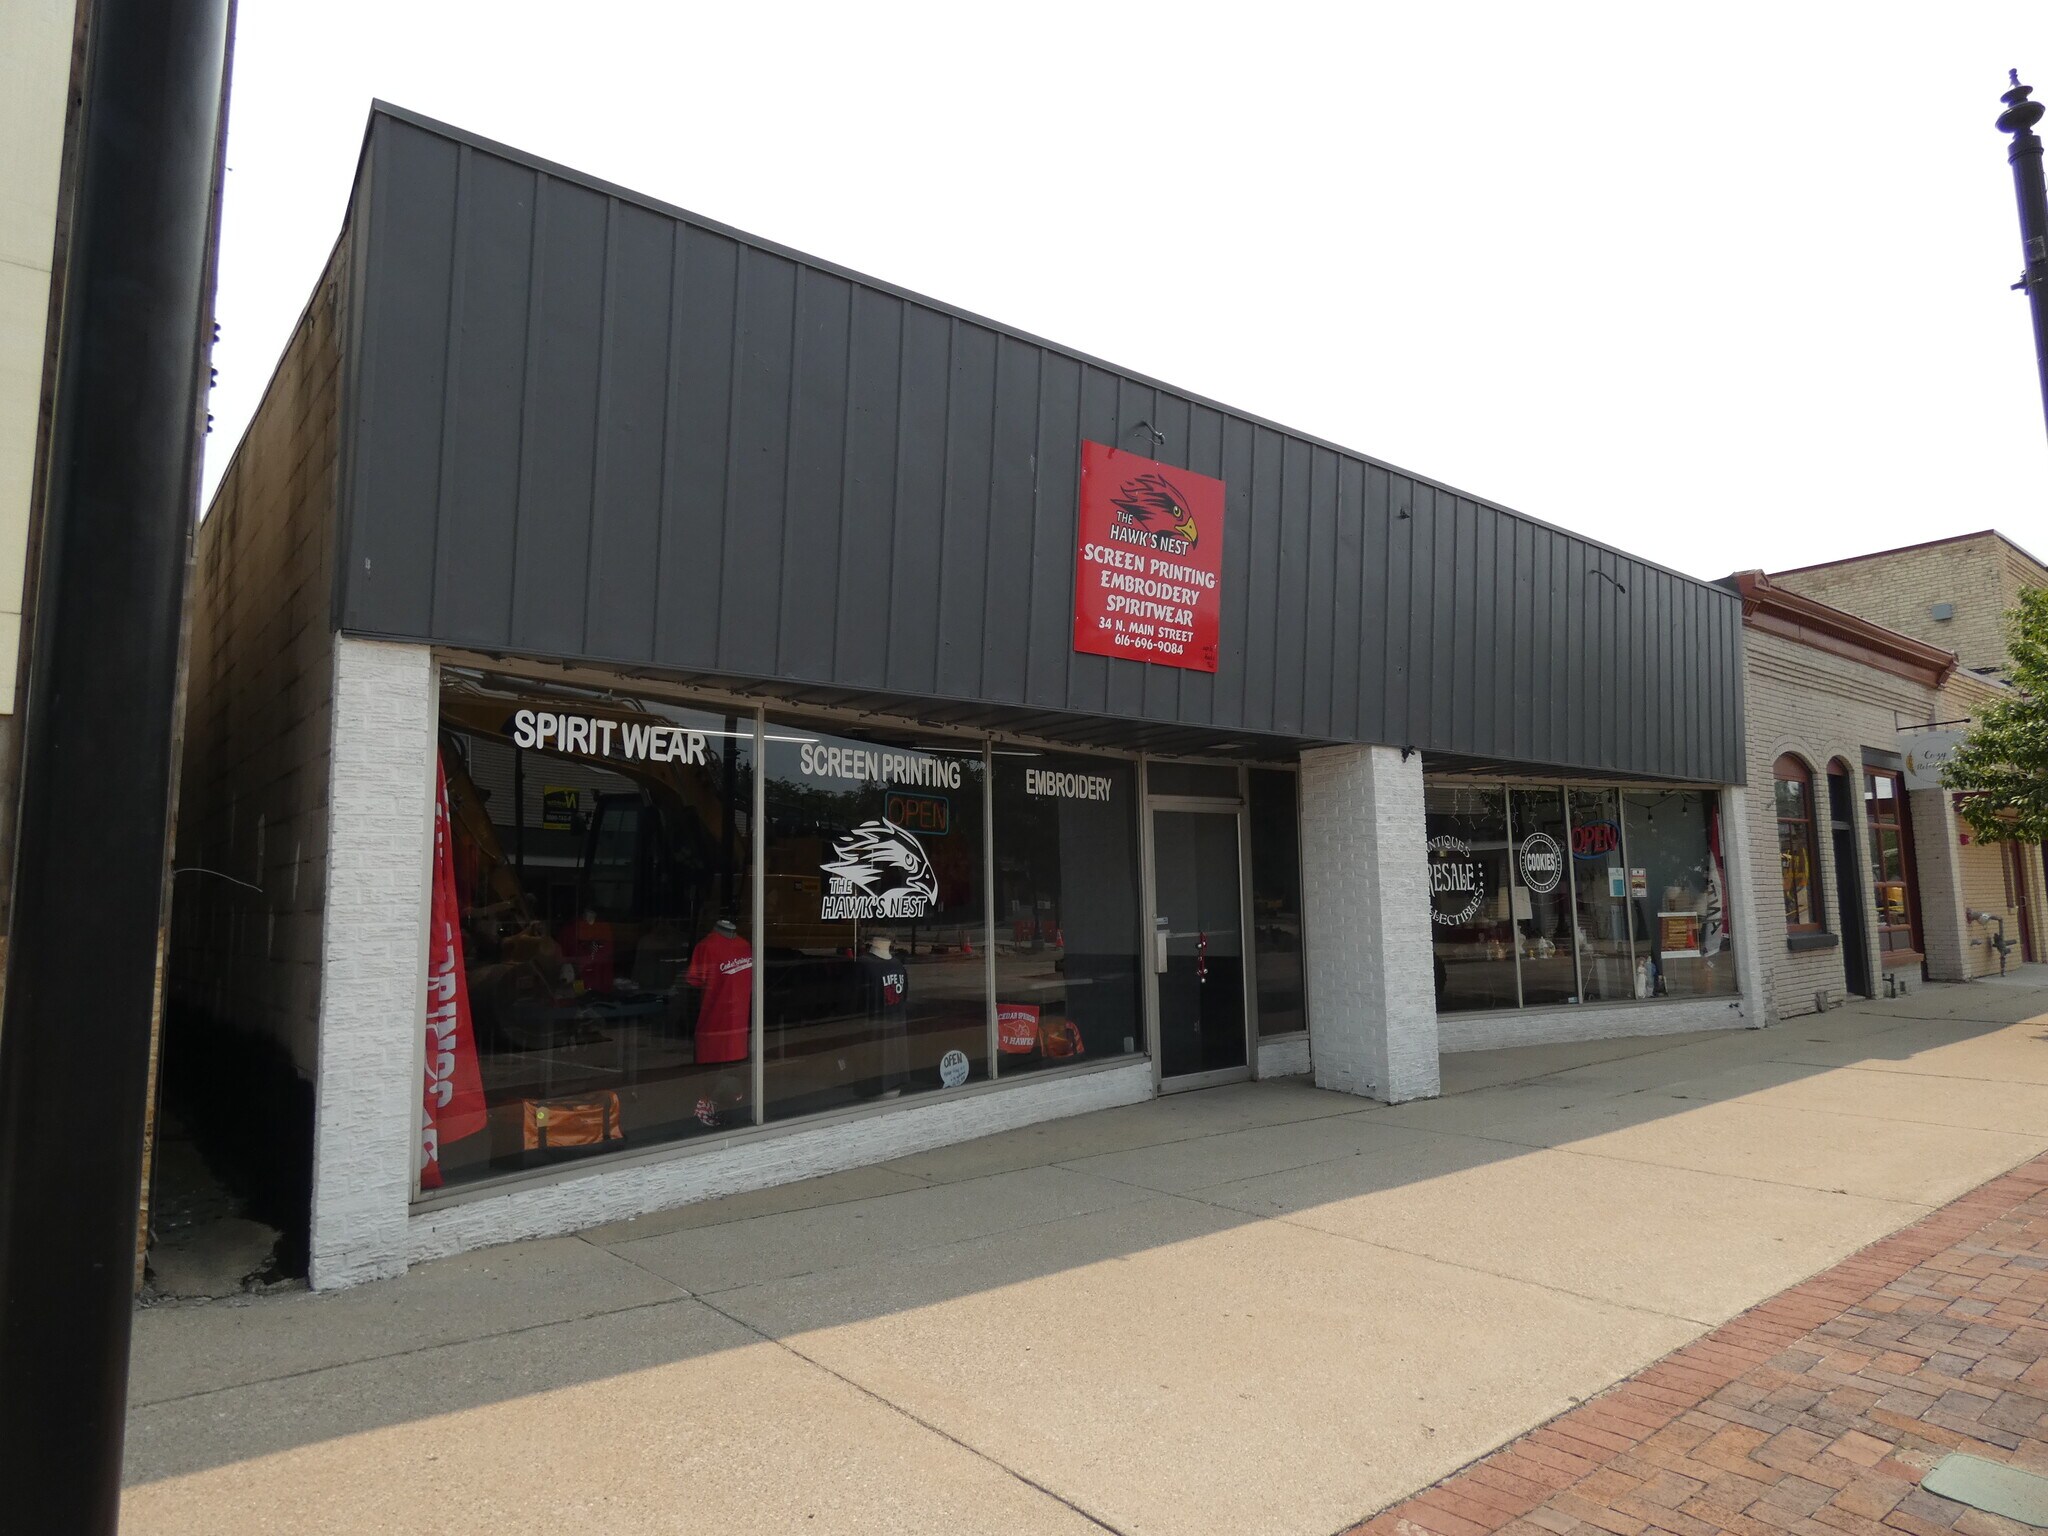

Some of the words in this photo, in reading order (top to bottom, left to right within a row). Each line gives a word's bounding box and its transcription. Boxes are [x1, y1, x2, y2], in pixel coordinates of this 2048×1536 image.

[1117, 511, 1133, 525] THE
[1110, 525, 1157, 549] HAWK'S
[1160, 537, 1189, 556] NEST
[1084, 543, 1145, 573] SCREEN
[1150, 558, 1215, 589] PRINTING
[1101, 570, 1200, 605] EMBROIDERY
[1107, 594, 1193, 627] SPIRITWEAR
[1099, 616, 1112, 629] 34
[1115, 620, 1126, 632] N.
[1129, 622, 1155, 637] MAIN
[1158, 626, 1194, 643] STREET
[1115, 633, 1184, 655] 616-696-9084
[514, 709, 617, 756] SPIRIT
[622, 722, 706, 766] WEAR
[800, 743, 878, 782] SCREEN
[882, 753, 961, 790] PRINTING
[1026, 768, 1112, 802] EMBROIDERY
[888, 797, 946, 829] OPEN
[1427, 835, 1471, 858] NTIQUES
[1572, 824, 1617, 852] OPEN
[1527, 853, 1556, 871] COOKIES
[829, 877, 853, 894] THE
[821, 896, 886, 919] HAWK'S
[888, 895, 928, 918] NEST
[1430, 887, 1485, 926] LECTIBLES
[882, 973, 898, 987] LIFE
[898, 974, 904, 985] IS
[1010, 1037, 1034, 1046] HAWKS
[943, 1052, 963, 1068] OPEN
